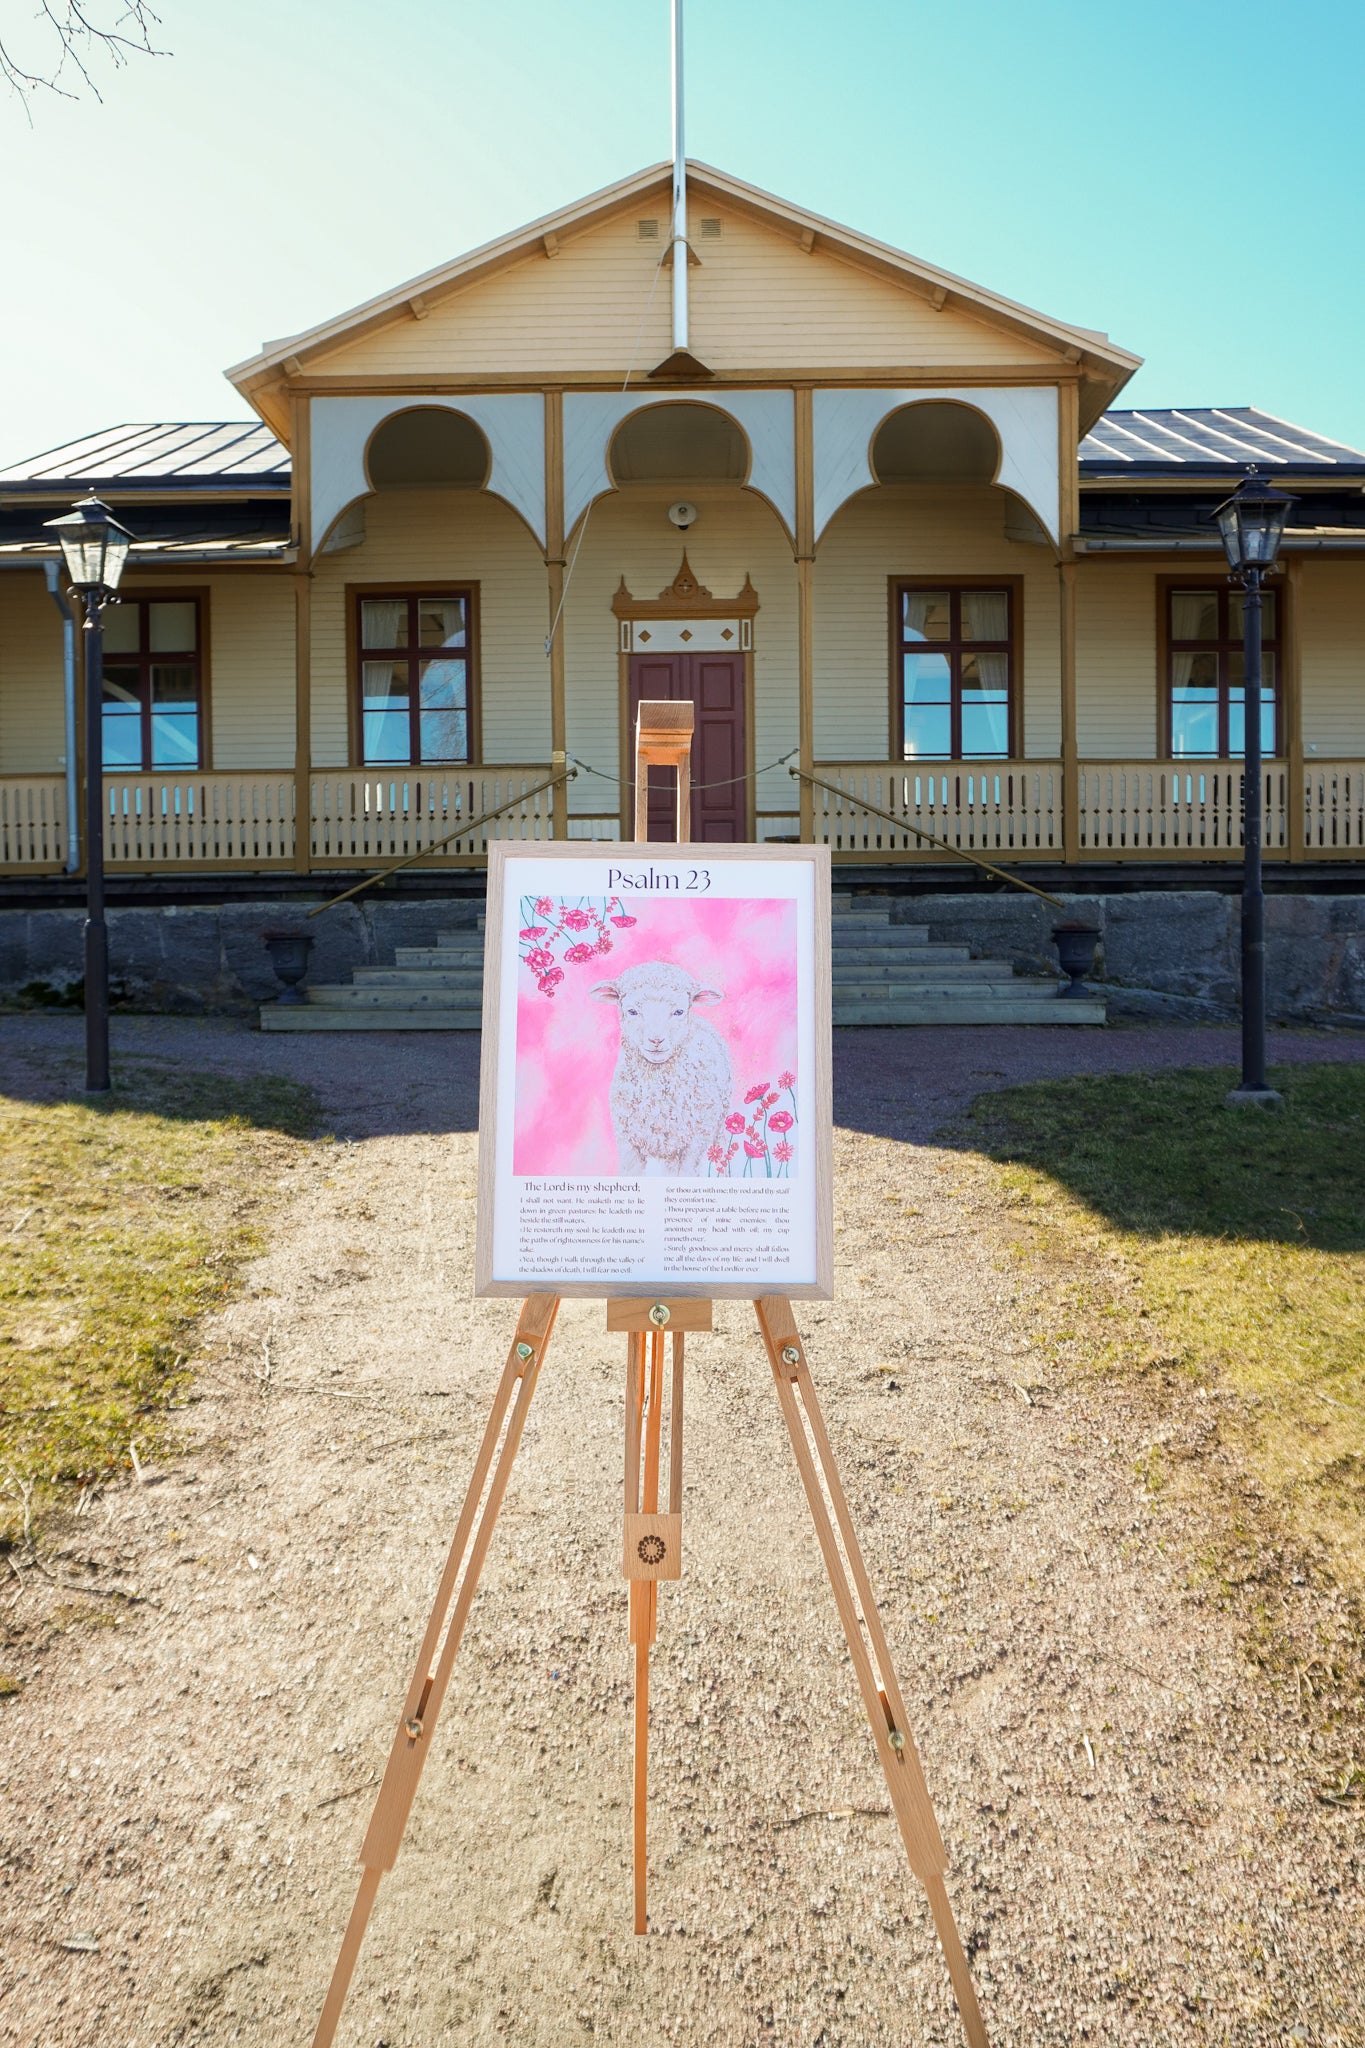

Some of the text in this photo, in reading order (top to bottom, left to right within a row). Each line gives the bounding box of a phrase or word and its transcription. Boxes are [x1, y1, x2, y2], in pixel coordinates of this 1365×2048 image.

[608, 867, 711, 894] Psalm 23
[525, 1182, 542, 1191] The
[544, 1182, 566, 1191] Lord
[567, 1182, 575, 1191] is
[576, 1184, 591, 1194] my
